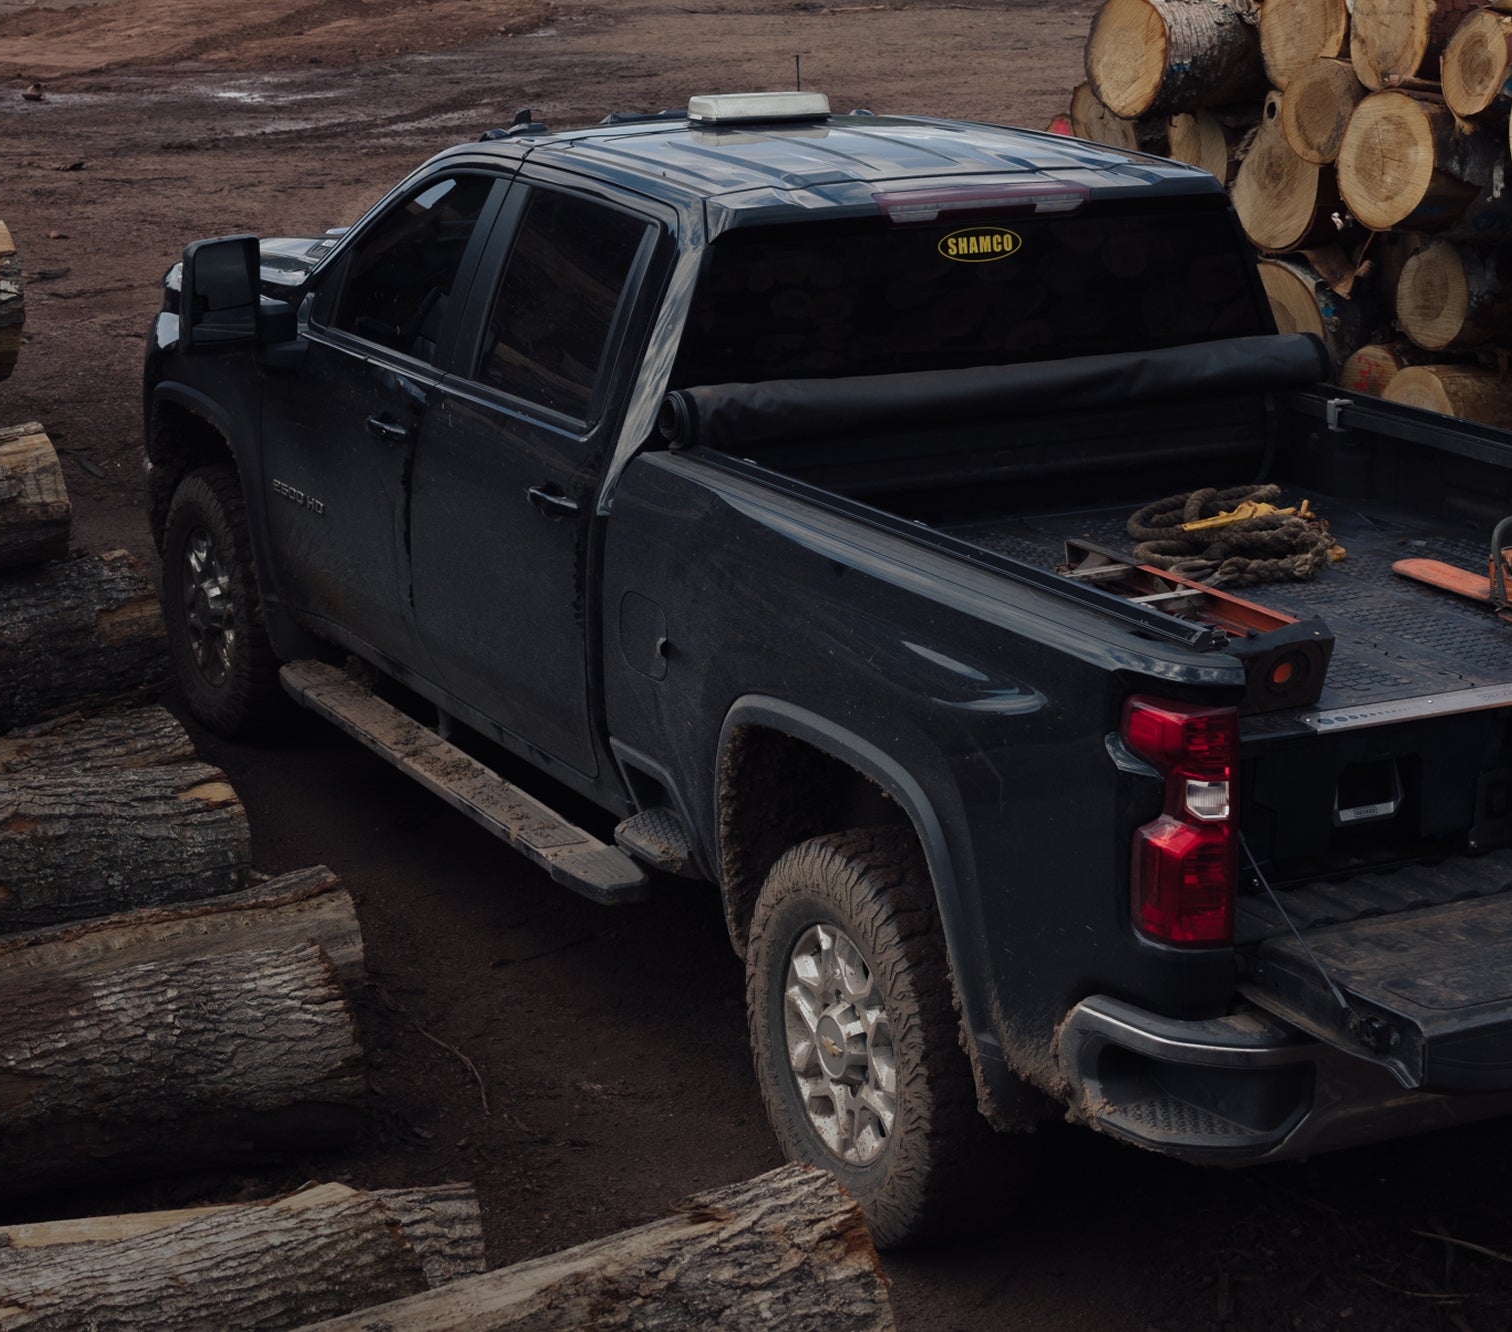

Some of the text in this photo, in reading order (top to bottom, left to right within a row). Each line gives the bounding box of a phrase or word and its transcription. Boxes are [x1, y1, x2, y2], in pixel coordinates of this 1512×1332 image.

[947, 233, 1013, 256] SHAMCO
[272, 478, 324, 515] 2500 HD
